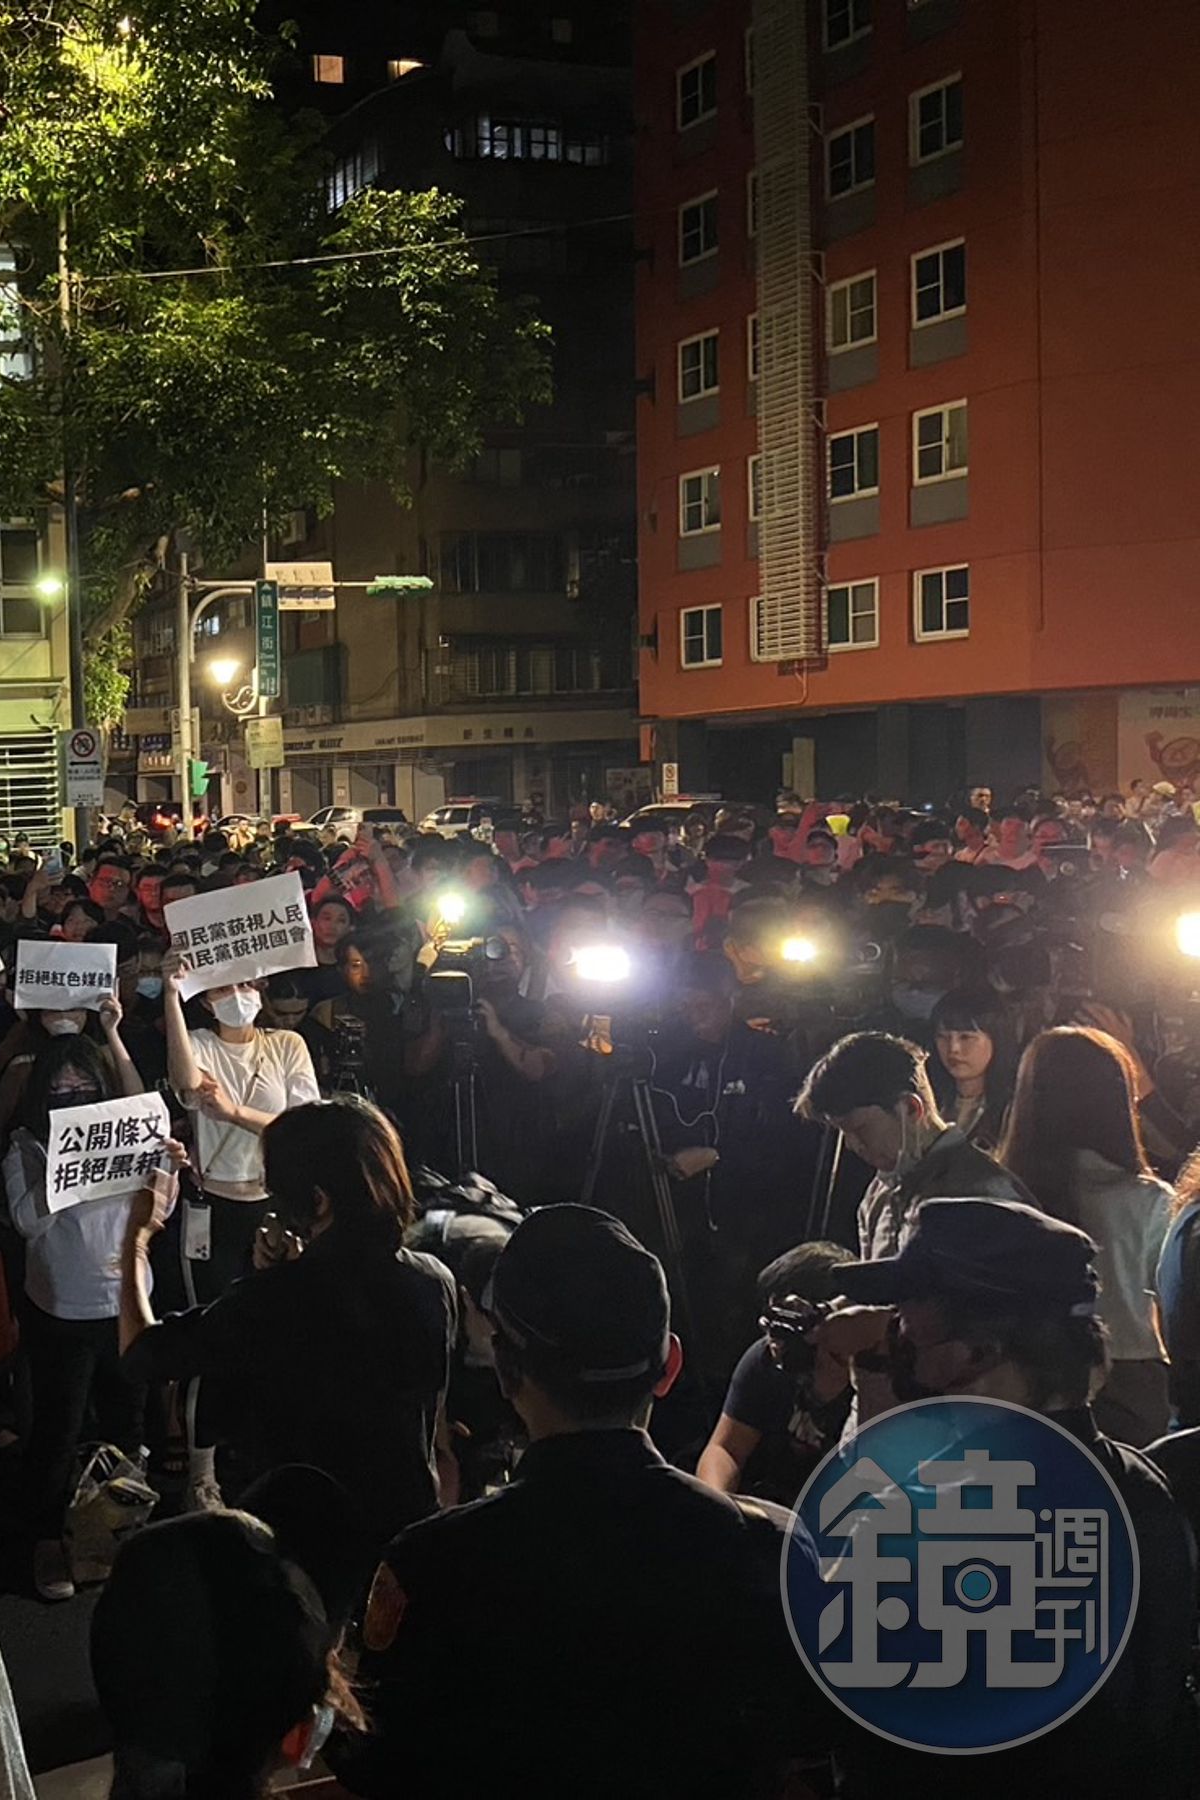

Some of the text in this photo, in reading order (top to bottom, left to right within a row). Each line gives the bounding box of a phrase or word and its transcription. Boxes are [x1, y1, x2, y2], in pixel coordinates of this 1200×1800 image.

[172, 904, 303, 949] 國民黨藐視人民
[58, 1110, 165, 1156] 公開條文
[54, 1148, 165, 1194] 拒絕黑箱
